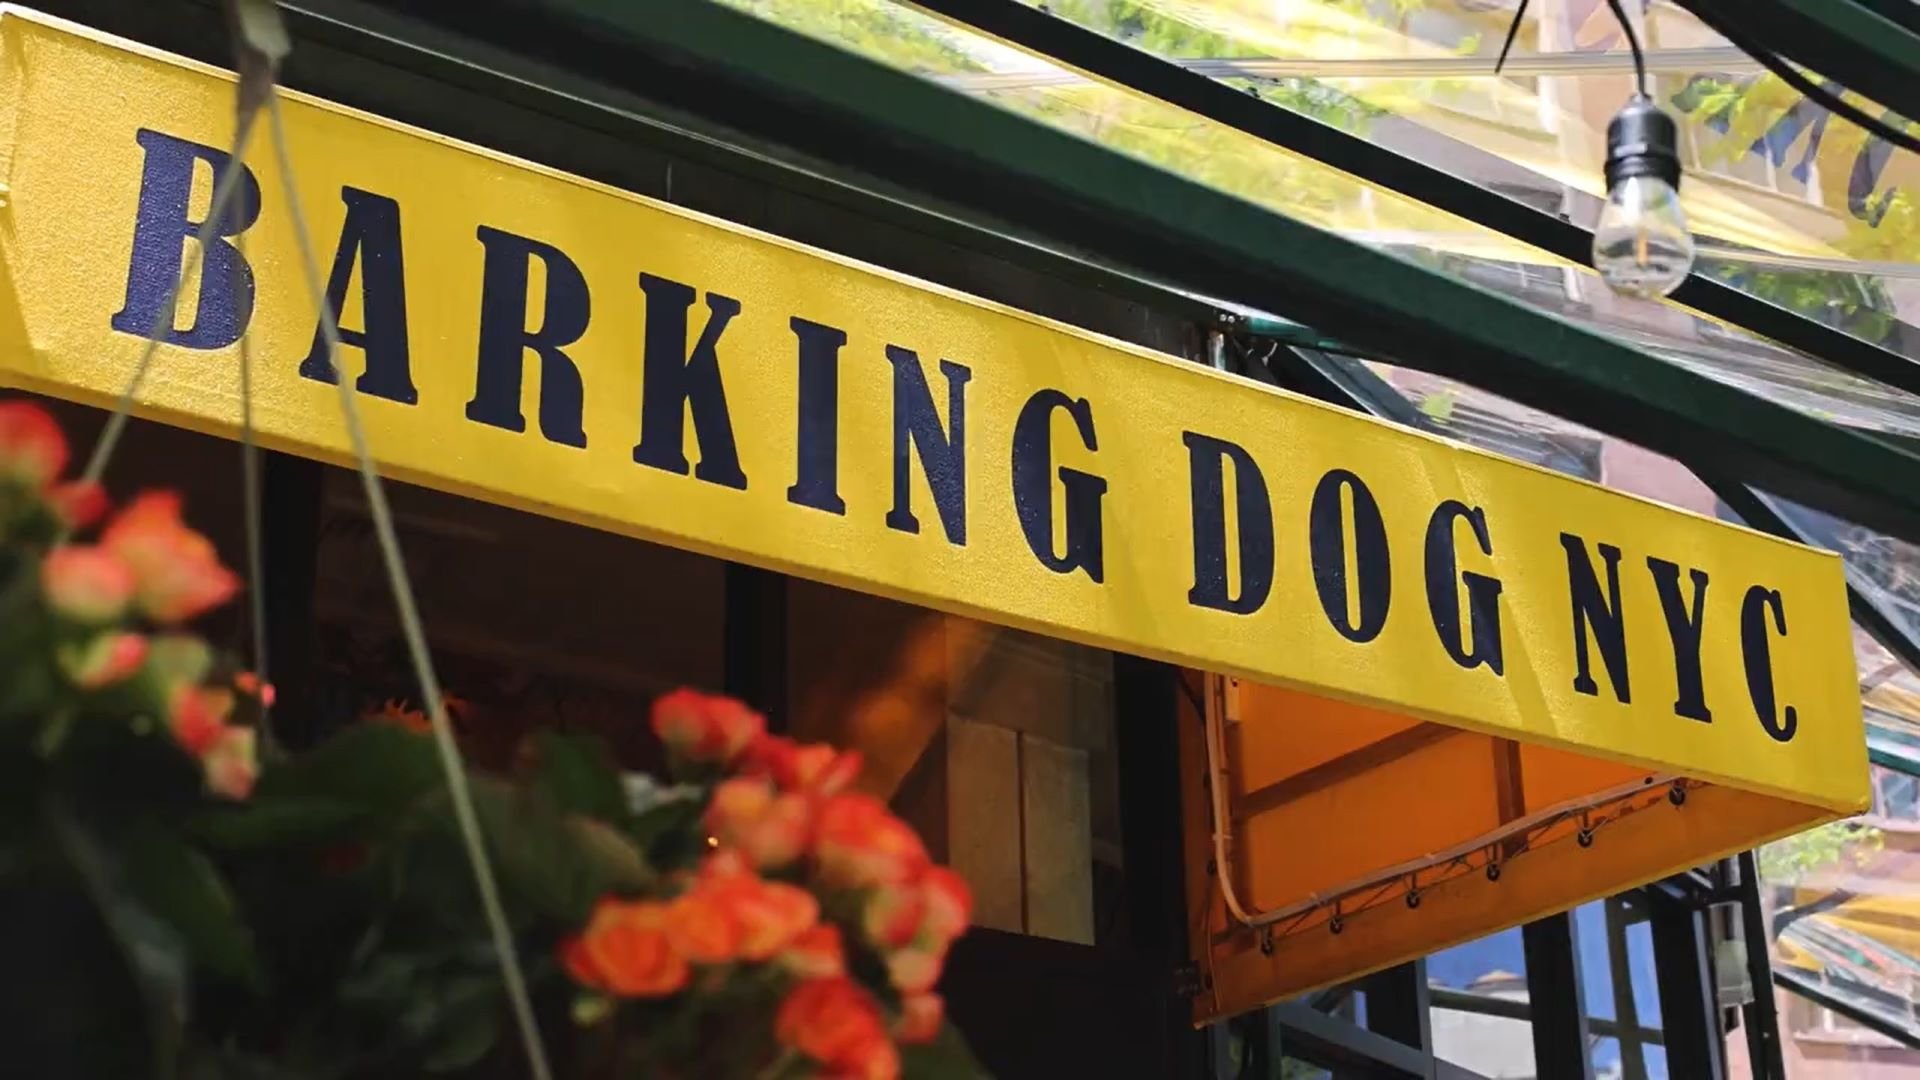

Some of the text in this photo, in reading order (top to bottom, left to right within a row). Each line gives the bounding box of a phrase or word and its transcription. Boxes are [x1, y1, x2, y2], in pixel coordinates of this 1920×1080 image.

[111, 128, 1798, 742] BARKING DOG NYC
